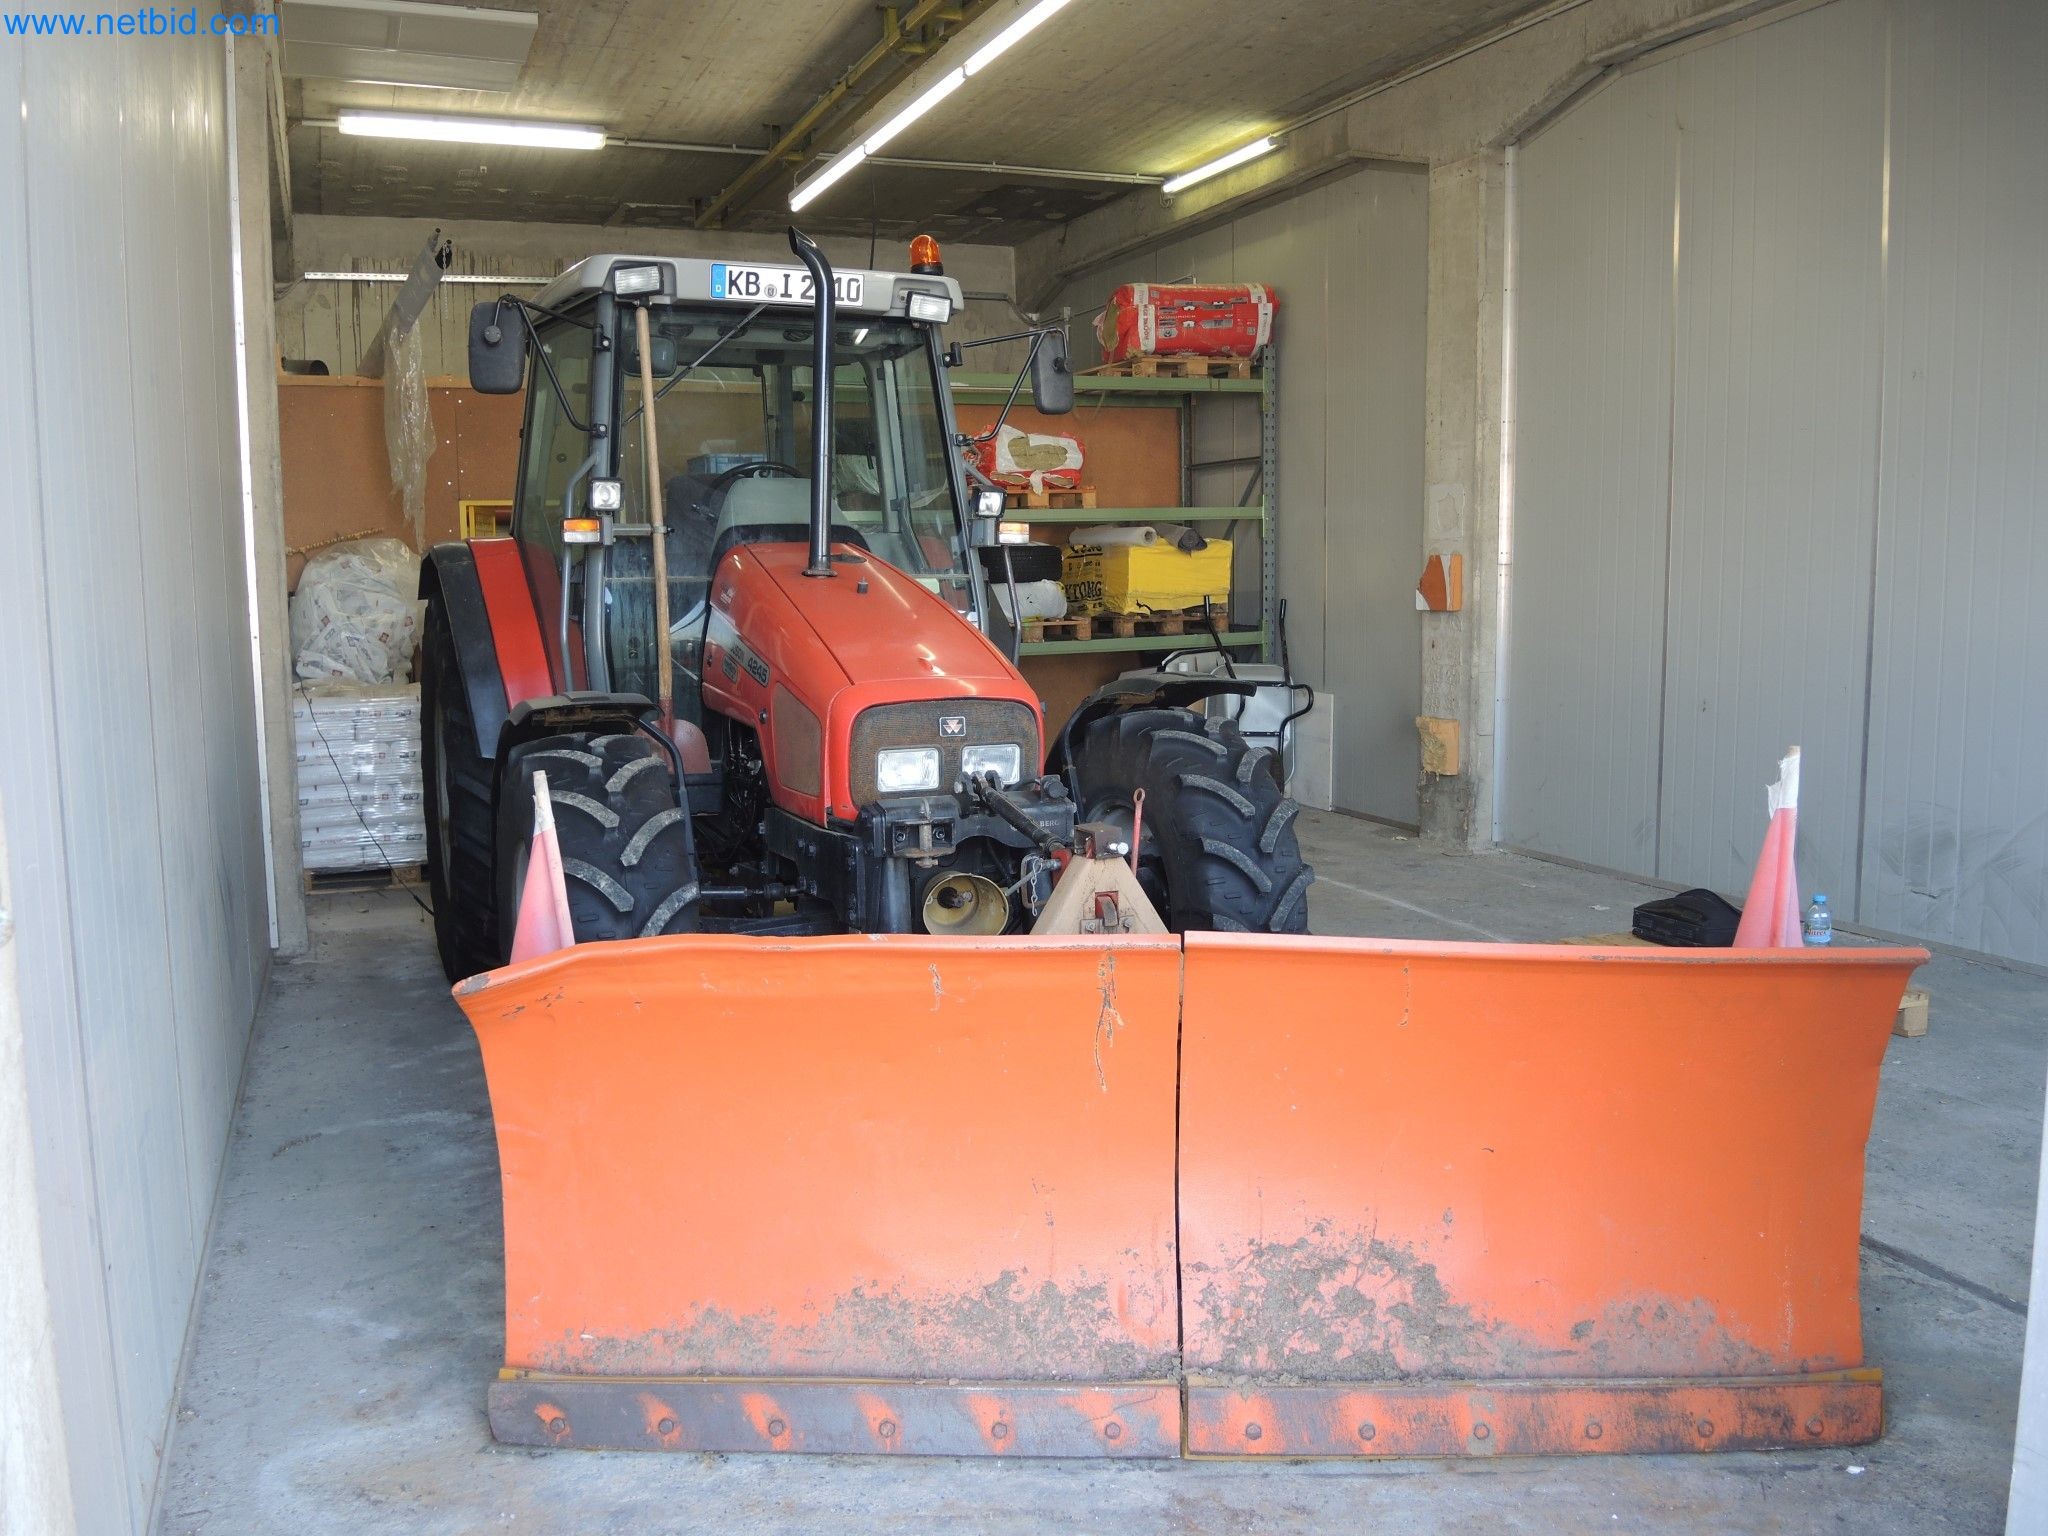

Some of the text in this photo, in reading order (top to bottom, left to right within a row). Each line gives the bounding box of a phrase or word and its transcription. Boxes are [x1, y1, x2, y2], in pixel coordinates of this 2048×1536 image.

[727, 270, 761, 297] KB
[800, 274, 861, 303] 210
[747, 656, 768, 683] 4245
